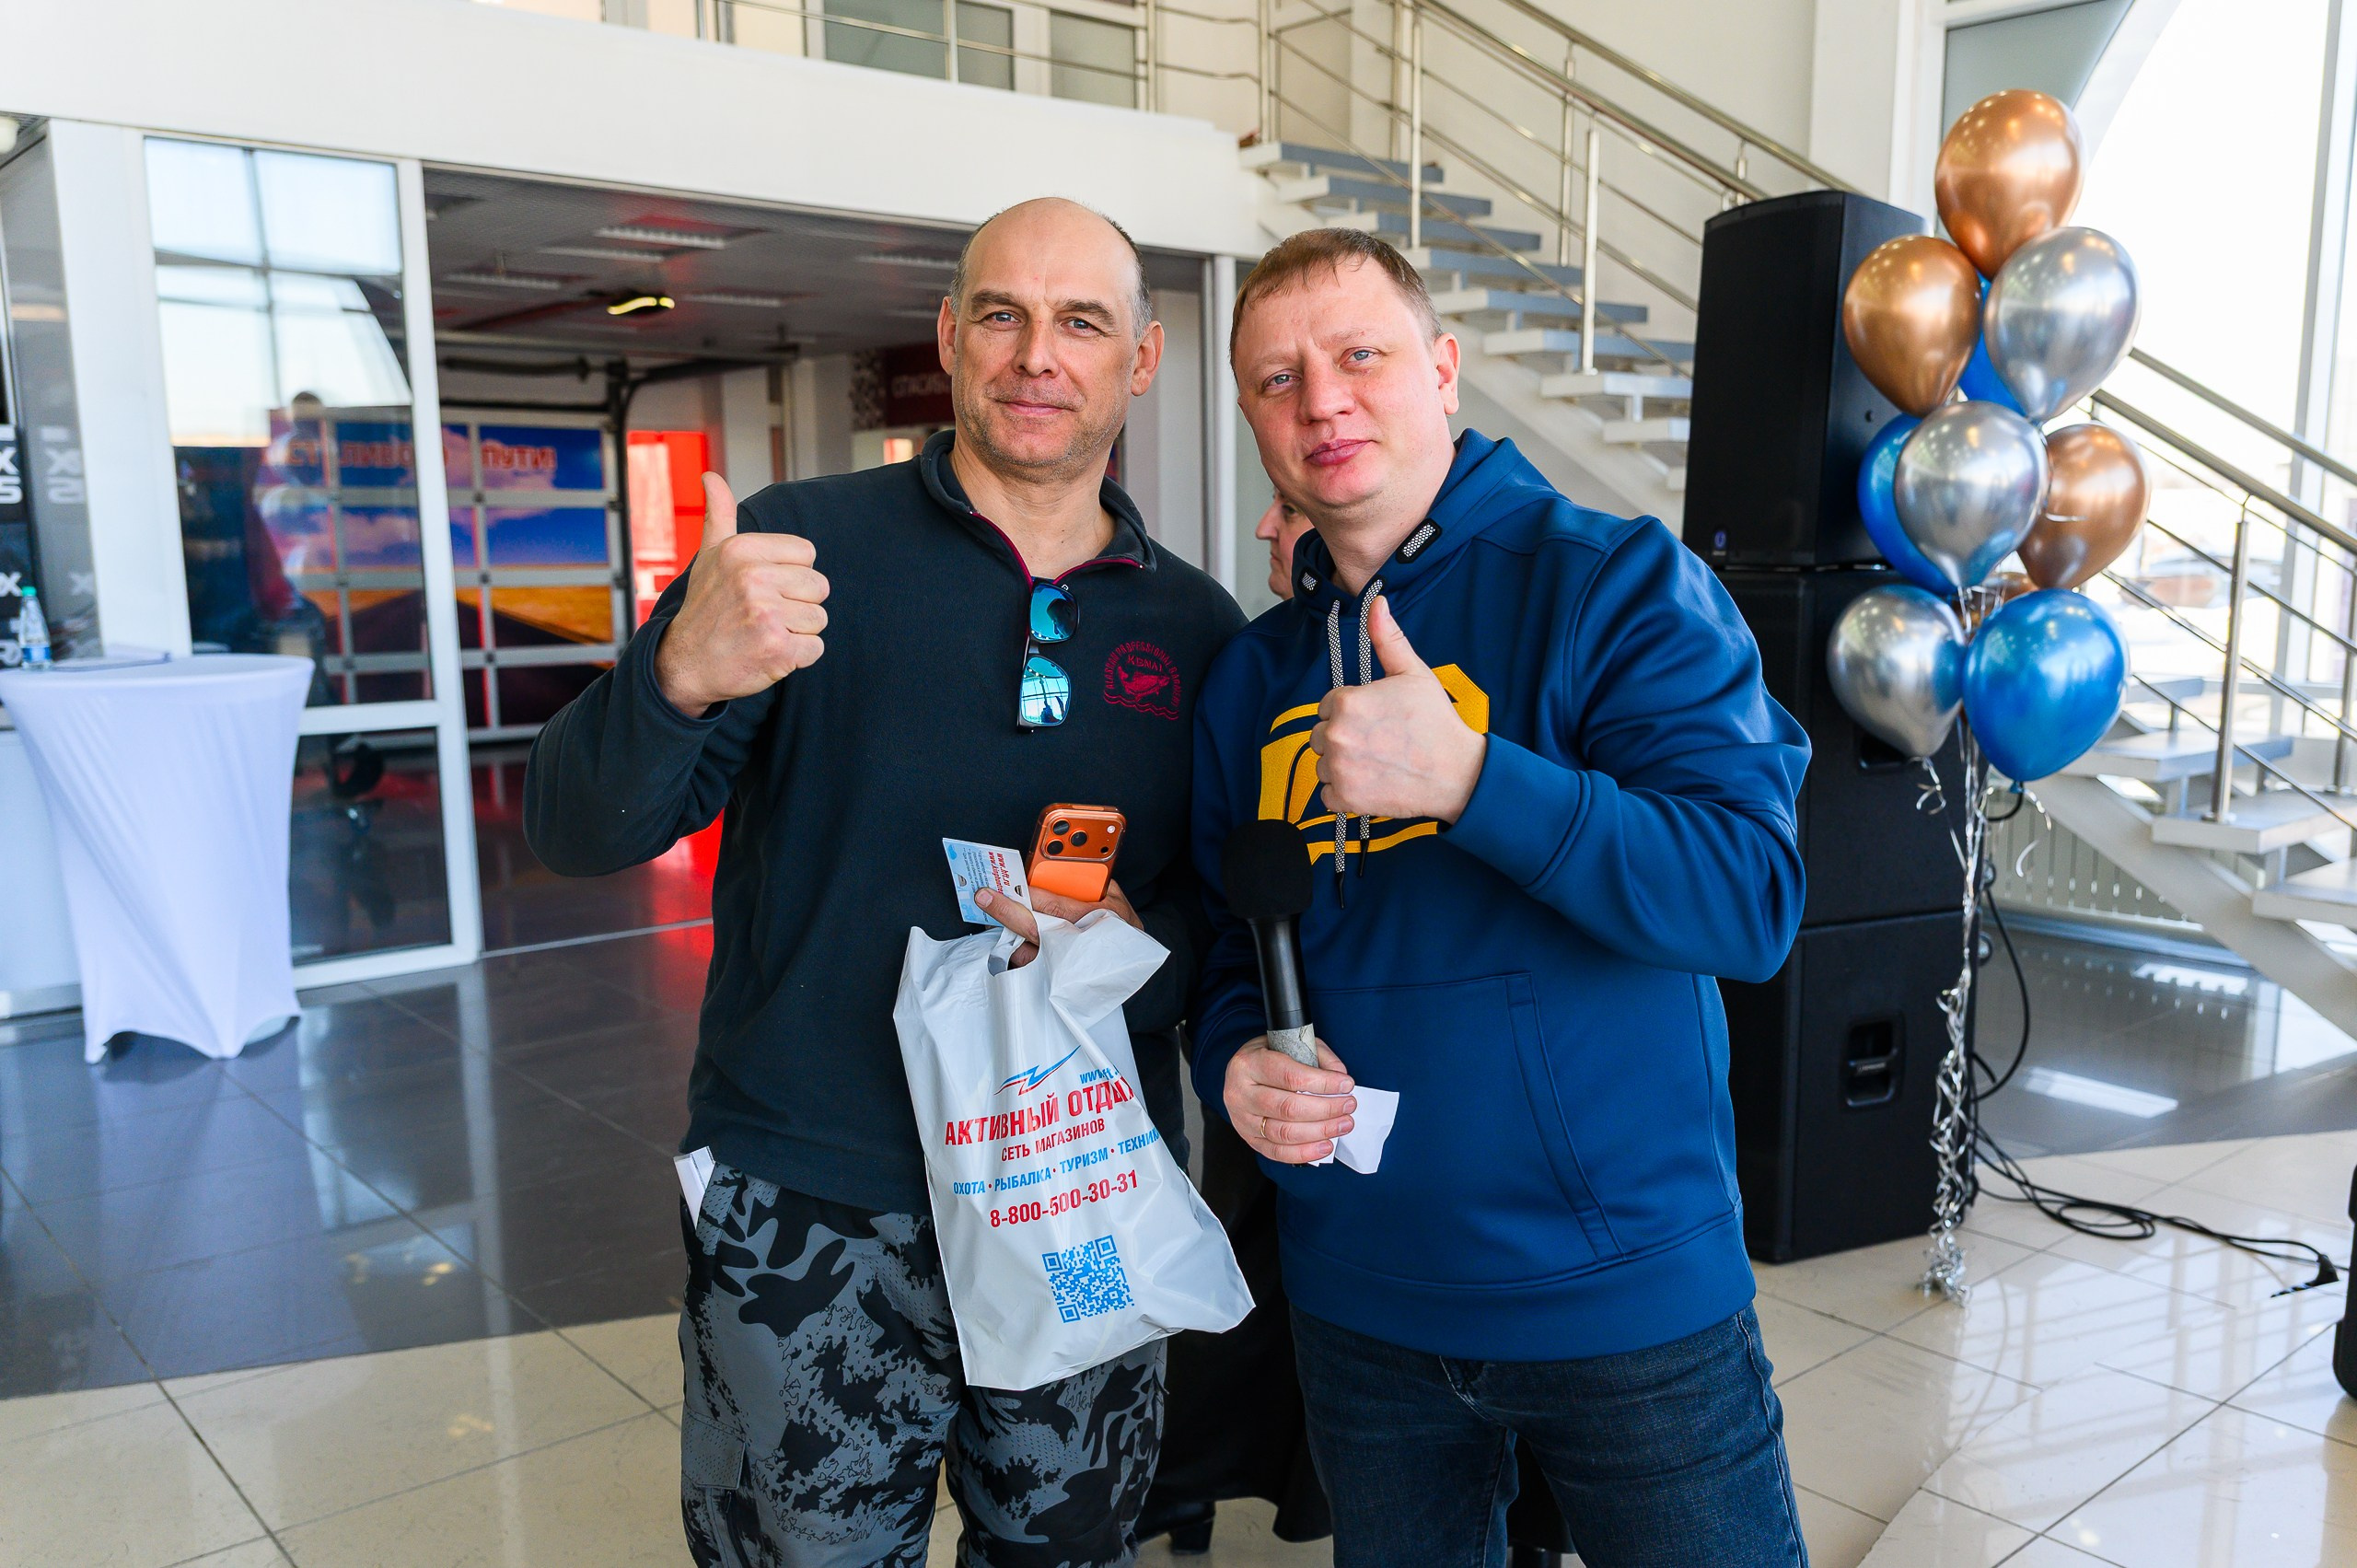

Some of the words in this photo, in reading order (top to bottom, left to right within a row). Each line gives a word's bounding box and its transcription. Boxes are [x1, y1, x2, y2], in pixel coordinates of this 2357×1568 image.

[1115, 640, 1174, 668] PROFESSIONAL
[1128, 655, 1163, 672] KENAI
[945, 1092, 1060, 1145] АКТИВНЫЙ
[1001, 1144, 1030, 1162] СЕТЬ
[1035, 1118, 1106, 1154] МАГАЗИНОВ
[953, 1180, 986, 1195] ОХОТА
[994, 1167, 1051, 1191] РЫБАЛКА
[1060, 1147, 1109, 1174] ТУРИЗМ
[1117, 1127, 1160, 1156] ТЕХНИК
[990, 1169, 1138, 1228] 8-800-500-30-31
